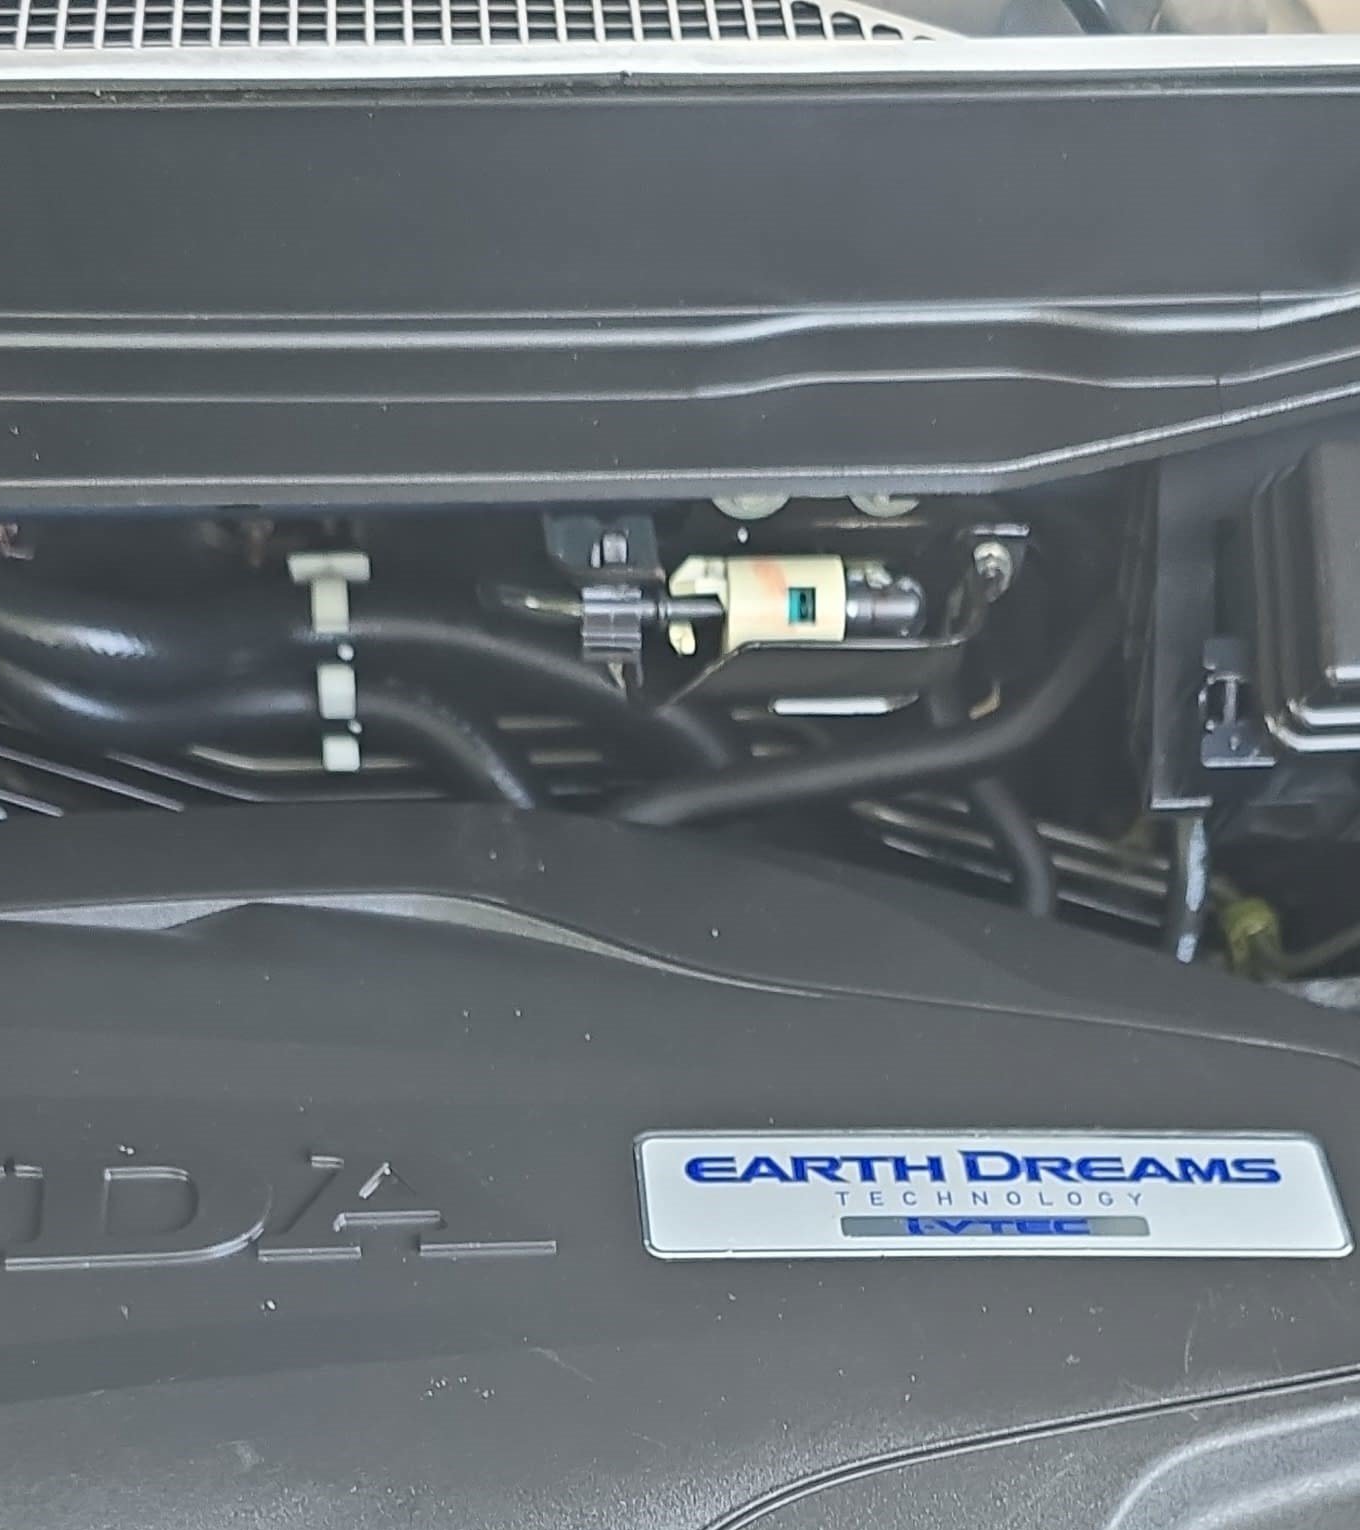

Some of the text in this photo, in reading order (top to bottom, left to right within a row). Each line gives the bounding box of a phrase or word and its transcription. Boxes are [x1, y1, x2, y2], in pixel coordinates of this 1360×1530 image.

[684, 1149, 1282, 1184] EARTH DREAMS
[834, 1190, 1143, 1206] TECHNOLOGY
